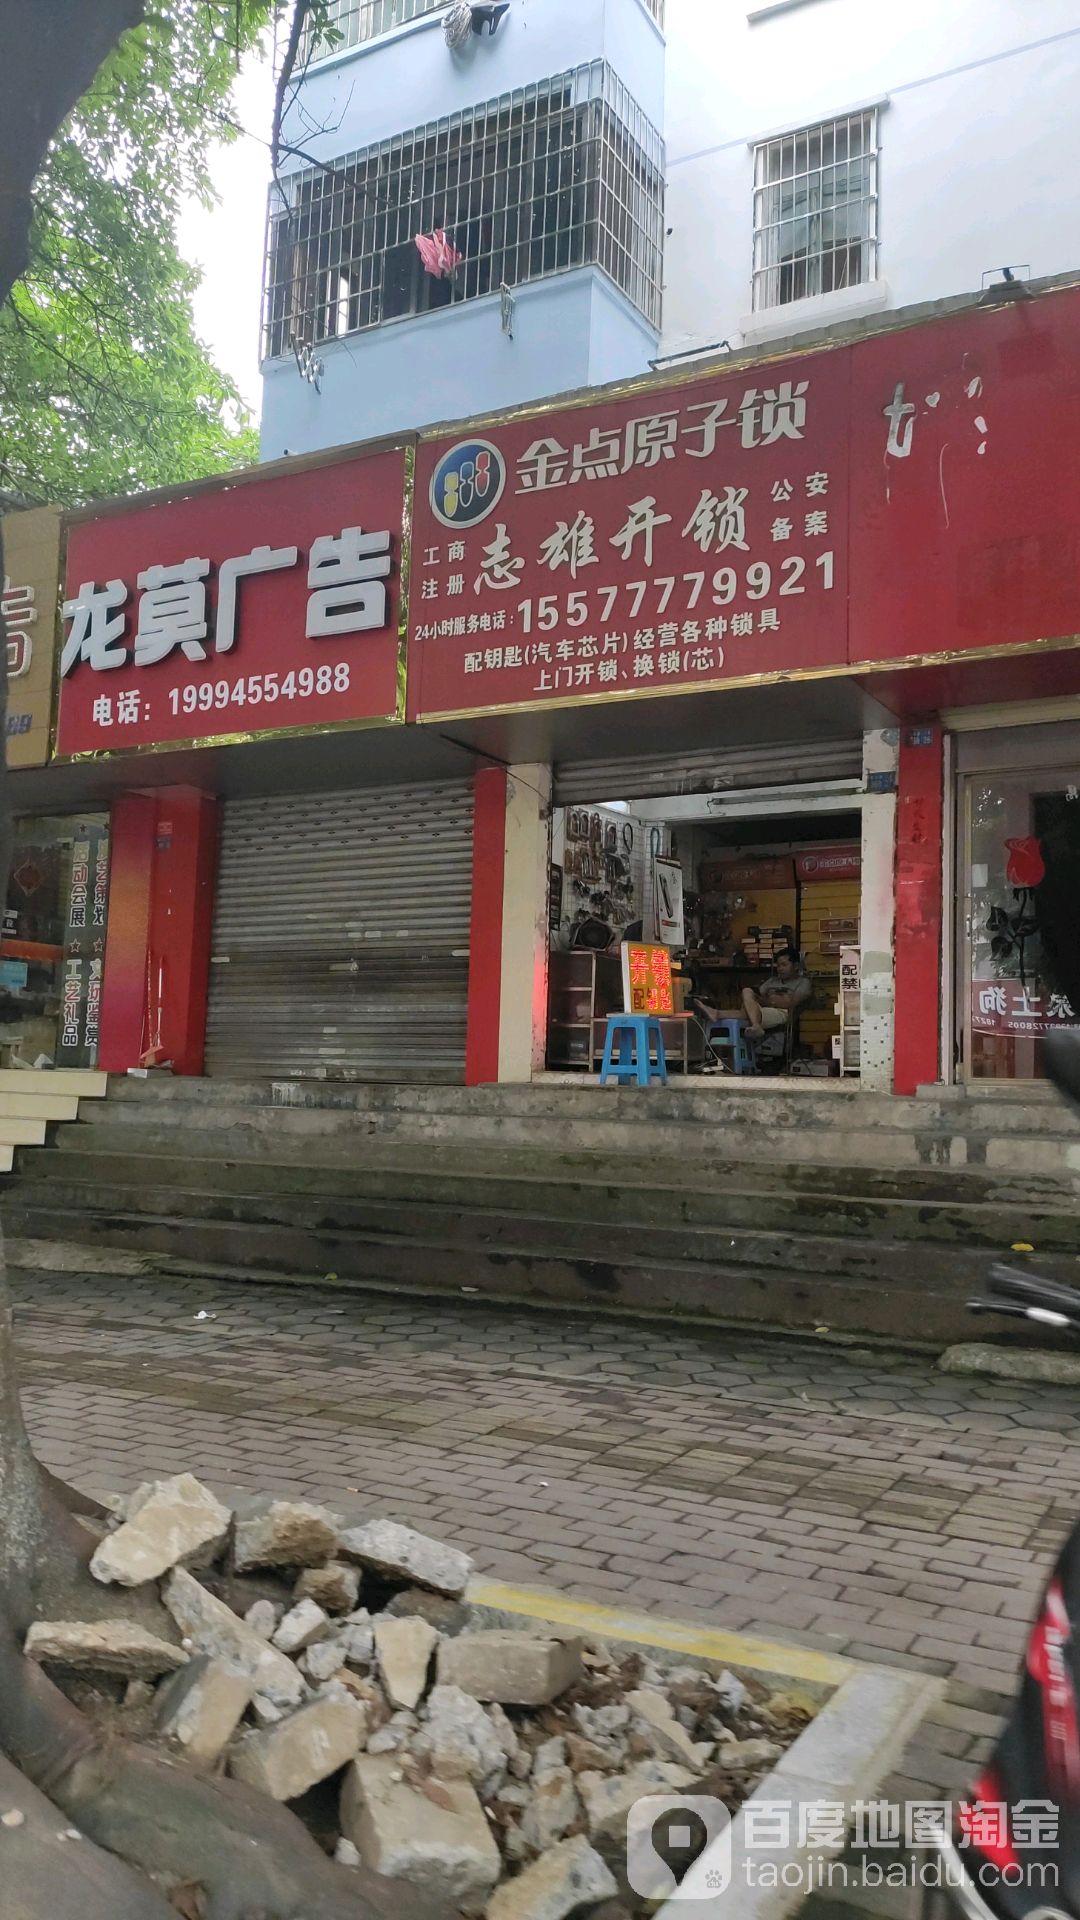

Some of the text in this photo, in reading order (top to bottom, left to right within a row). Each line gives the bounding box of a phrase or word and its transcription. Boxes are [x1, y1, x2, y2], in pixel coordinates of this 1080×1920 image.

[514, 381, 810, 494] 金点原子锁
[770, 471, 829, 502] 公安
[422, 540, 465, 566] 工商
[473, 486, 750, 595] 志雄开锁
[770, 511, 828, 542] 备案
[61, 526, 391, 678] 龙莫广告
[421, 575, 465, 600] 注册
[517, 551, 835, 633] 15577779921
[168, 663, 350, 715] 19994554988
[62, 958, 82, 1047] 工艺礼品
